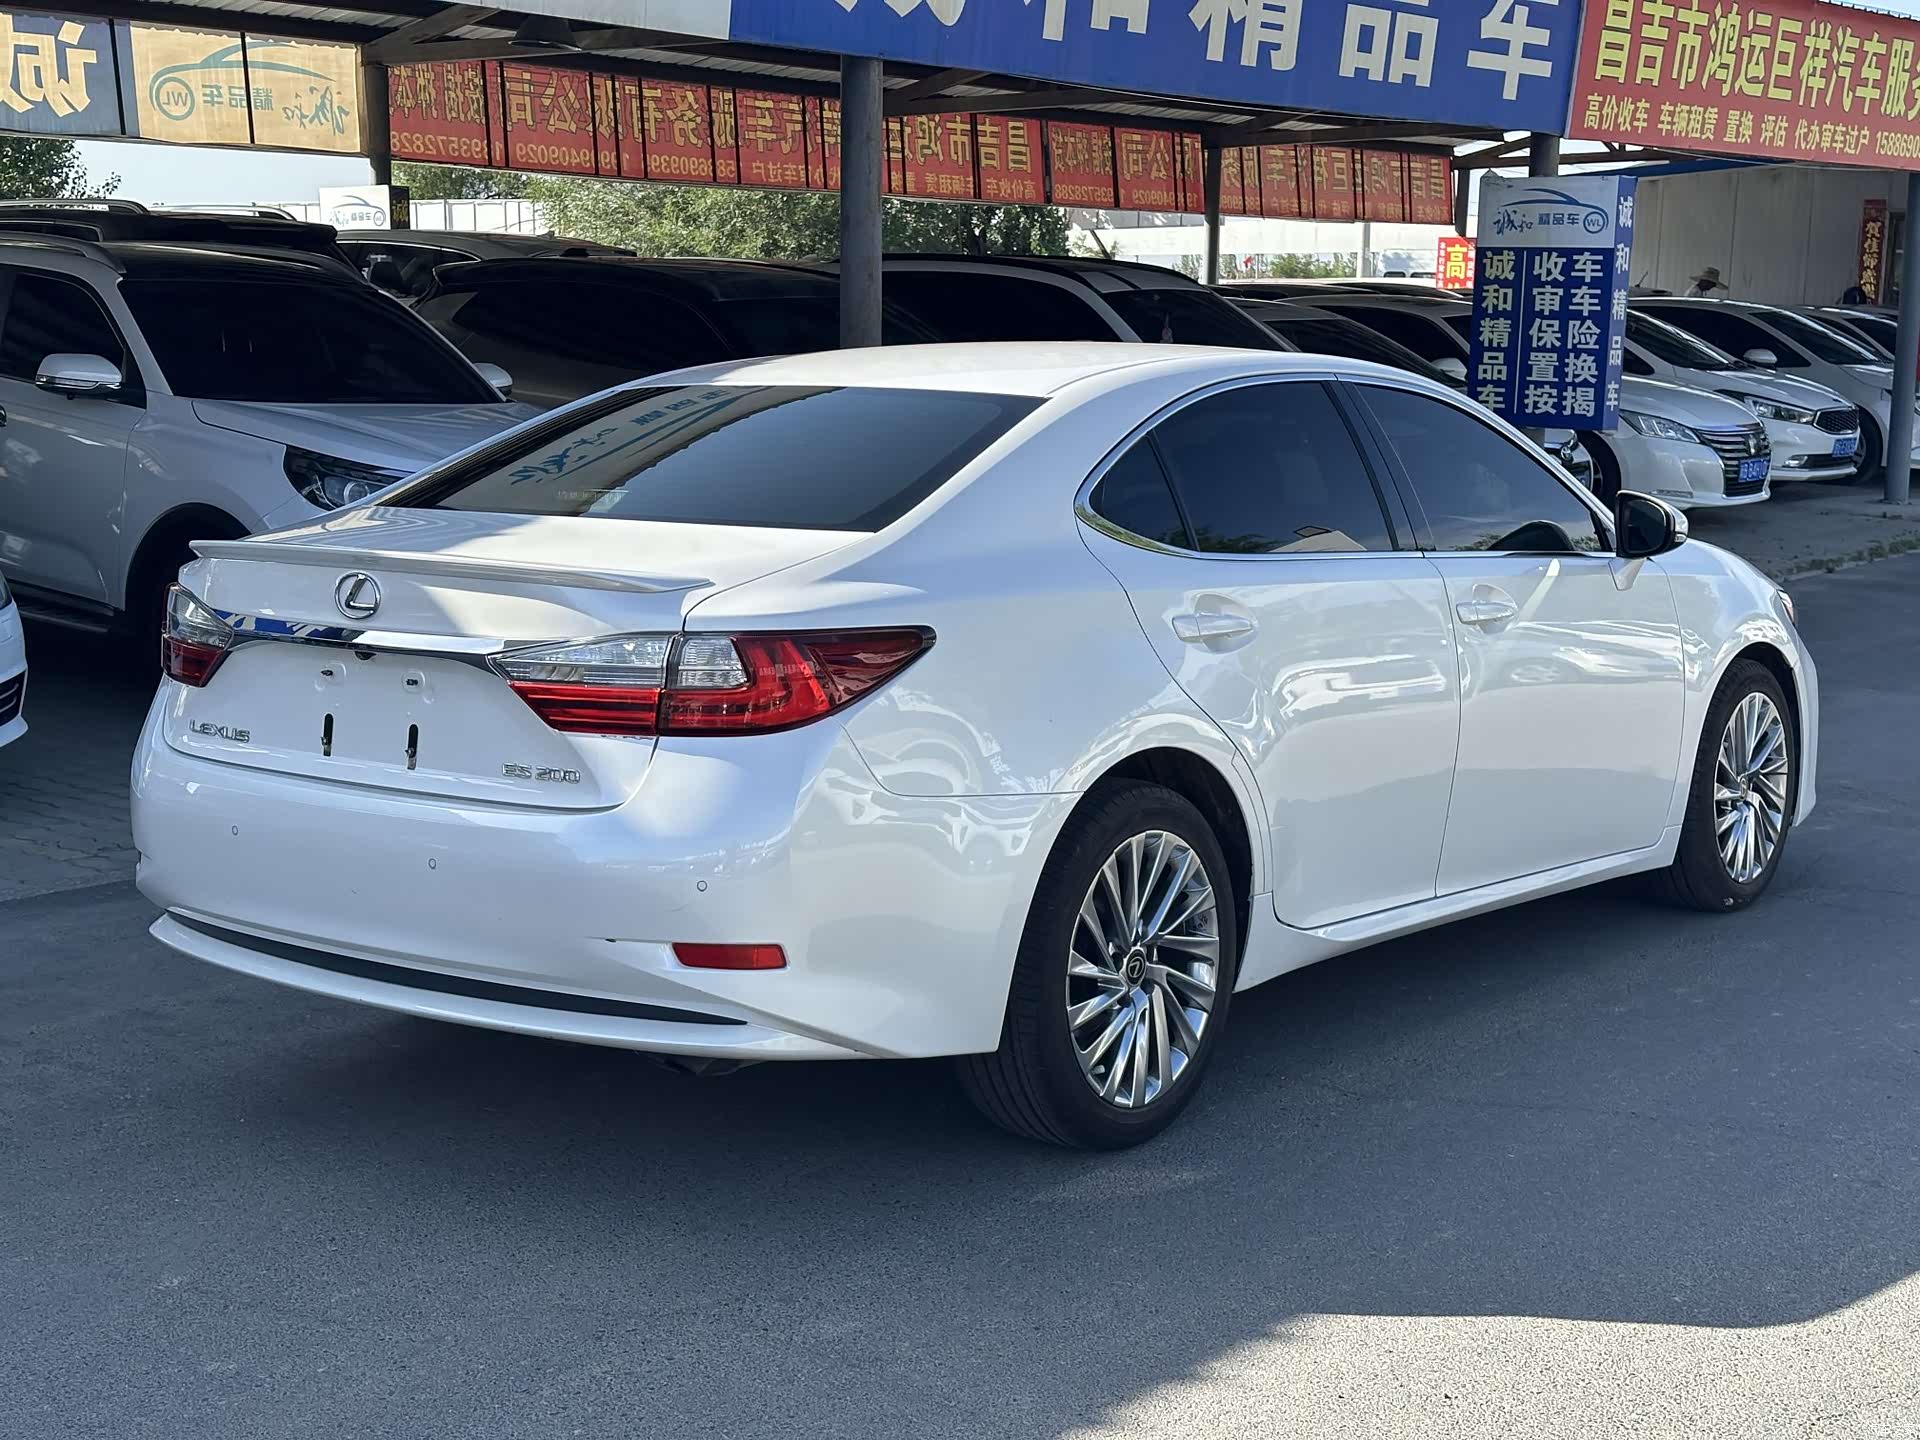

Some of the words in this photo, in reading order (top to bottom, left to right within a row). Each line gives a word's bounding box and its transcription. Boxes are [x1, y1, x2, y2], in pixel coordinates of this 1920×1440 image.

[1584, 92, 1650, 134] 高价收车
[1657, 101, 1719, 141] 车辆租赁
[1723, 109, 1753, 144] 置换
[1760, 114, 1788, 148] 评估
[1794, 118, 1870, 155] 代办审车过户
[1586, 218, 1602, 228] WL
[1446, 243, 1467, 280] 高
[1532, 251, 1603, 282] 收车
[1532, 285, 1602, 316] 审车
[1606, 196, 1633, 412] 诚和精品车
[1476, 250, 1516, 412] 诚和精品车
[1528, 318, 1601, 350] 保险
[1526, 351, 1599, 384] 置换
[1524, 384, 1596, 417] 按揭
[188, 719, 251, 744] LEXUS
[502, 762, 532, 779] ES
[535, 766, 581, 784] 200
